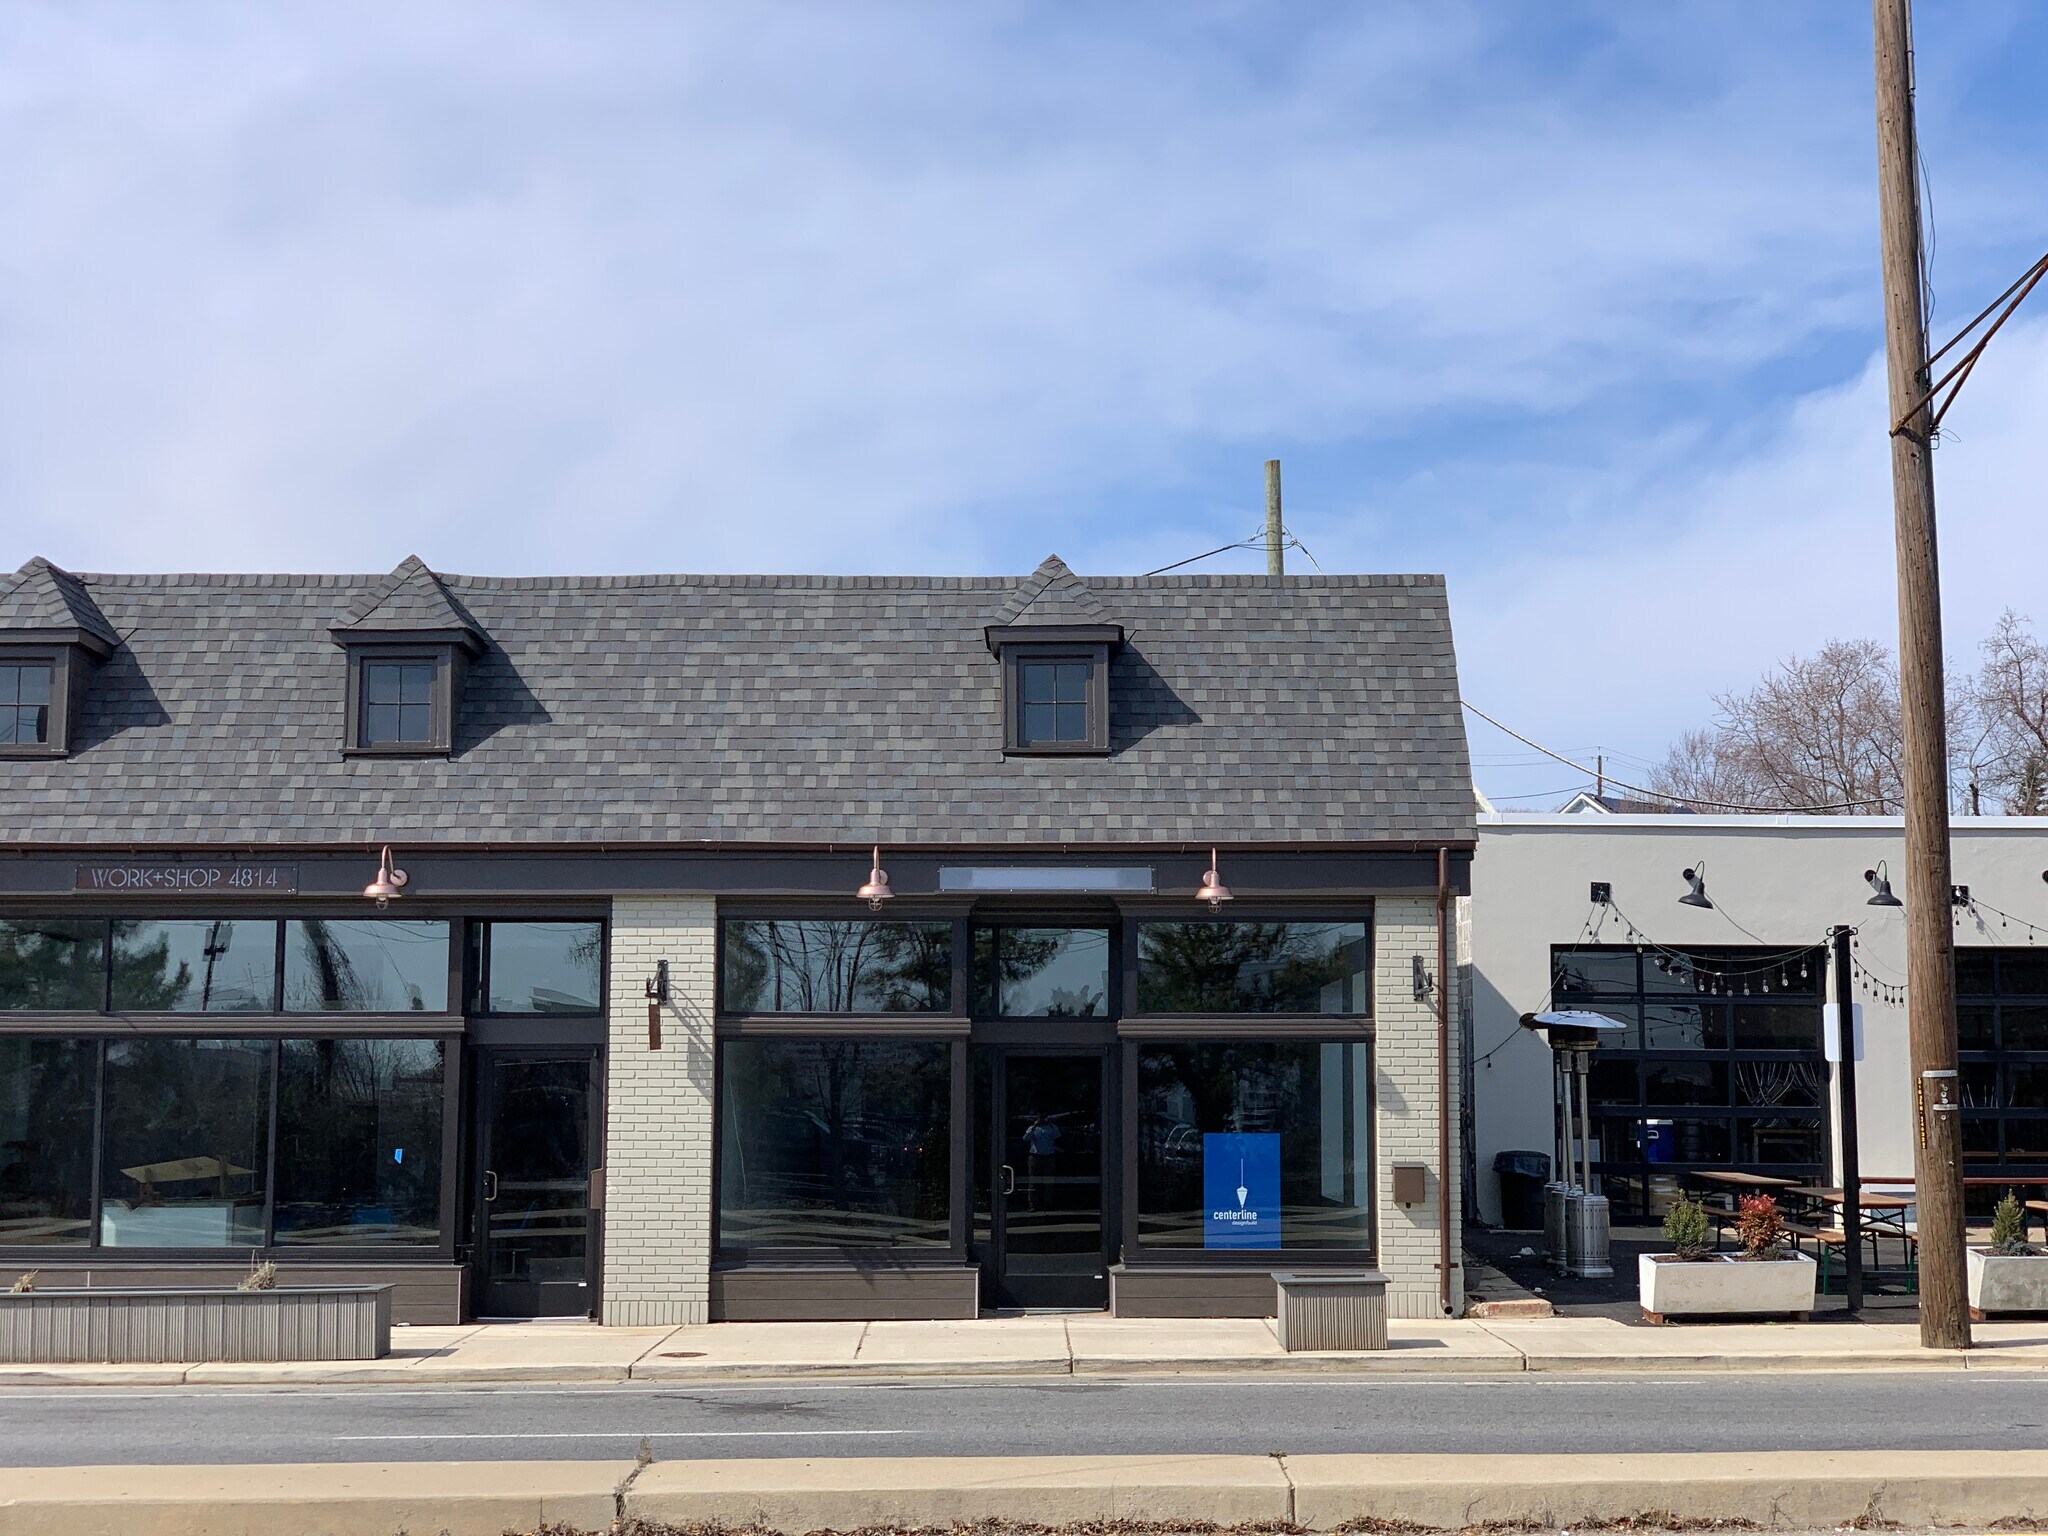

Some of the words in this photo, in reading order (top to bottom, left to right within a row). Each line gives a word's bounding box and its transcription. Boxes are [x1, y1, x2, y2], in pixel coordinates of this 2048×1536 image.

[91, 868, 221, 887] WORK+SHOP
[228, 868, 277, 887] 4814
[1213, 1210, 1257, 1220] centerline
